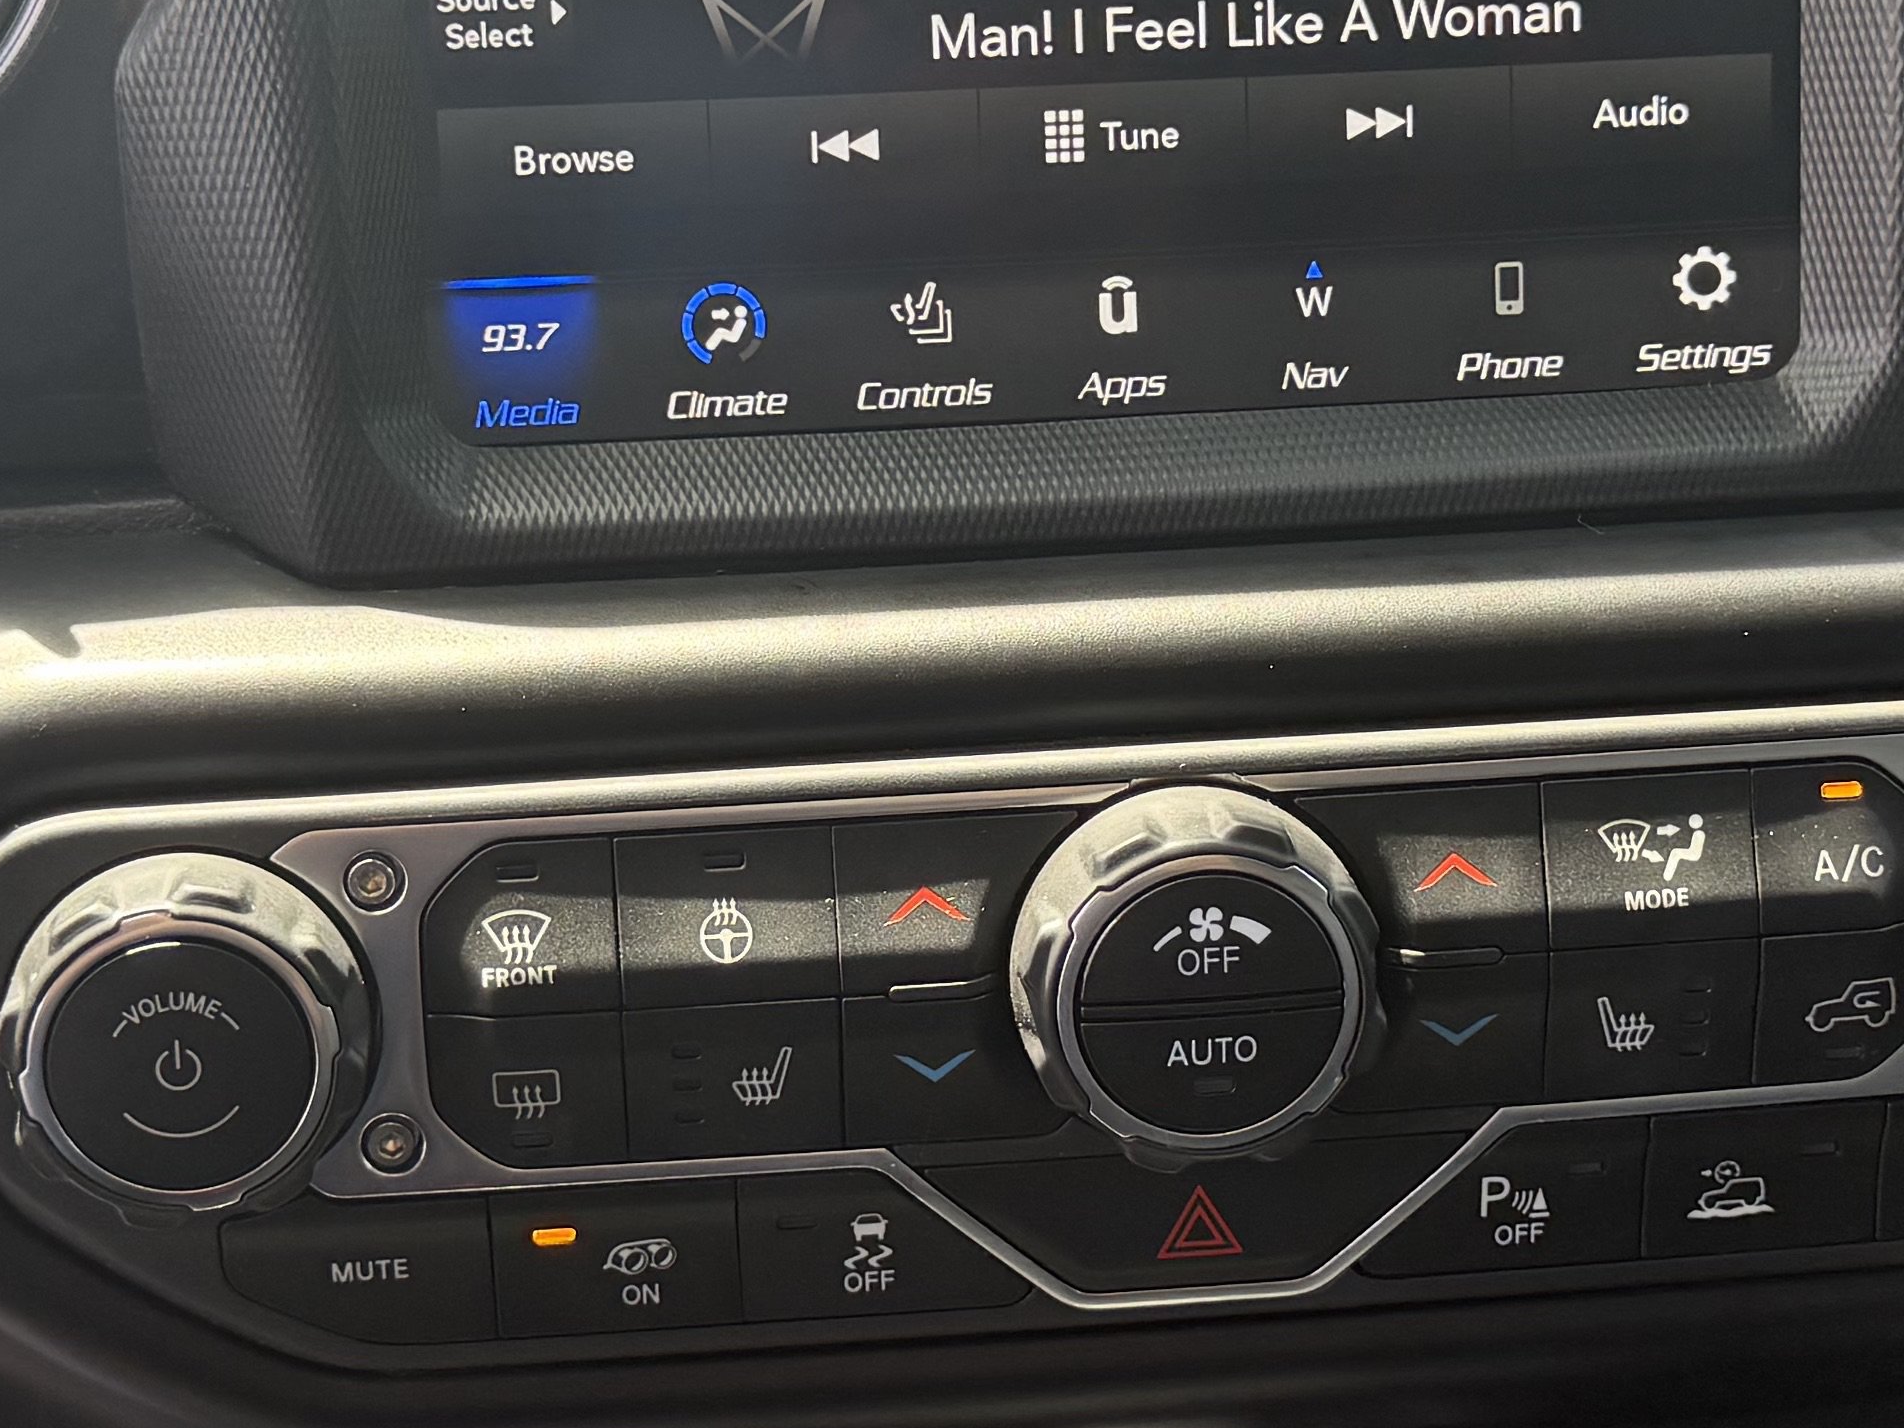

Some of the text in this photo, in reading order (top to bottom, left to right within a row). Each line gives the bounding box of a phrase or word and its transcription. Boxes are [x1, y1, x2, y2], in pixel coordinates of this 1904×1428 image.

[444, 23, 534, 51] Select
[930, 10, 1054, 60] Man!
[1074, 9, 1085, 54] I
[1105, 1, 1207, 53] Feel
[1593, 98, 1690, 130] Audio
[1100, 121, 1180, 153] Tune
[513, 145, 635, 176] Browse
[1296, 287, 1333, 318] W
[481, 322, 560, 353] 93.7
[1456, 351, 1564, 381] Phone
[1636, 341, 1773, 374] Settings
[1078, 372, 1166, 404] Apps
[1281, 361, 1349, 390] Nav
[667, 389, 788, 421] Climate
[857, 378, 994, 412] Controls
[475, 399, 580, 429] Media
[1814, 845, 1885, 883] A/C
[1624, 887, 1690, 911] MODE
[481, 965, 557, 989] FRONT
[1177, 946, 1241, 977] OFF
[122, 992, 222, 1025] VOLUME
[1167, 1036, 1258, 1068] AUTO
[1494, 1222, 1545, 1246] OFF
[330, 1258, 410, 1284] MUTE
[843, 1271, 896, 1293] OFF
[621, 1283, 661, 1305] ON
